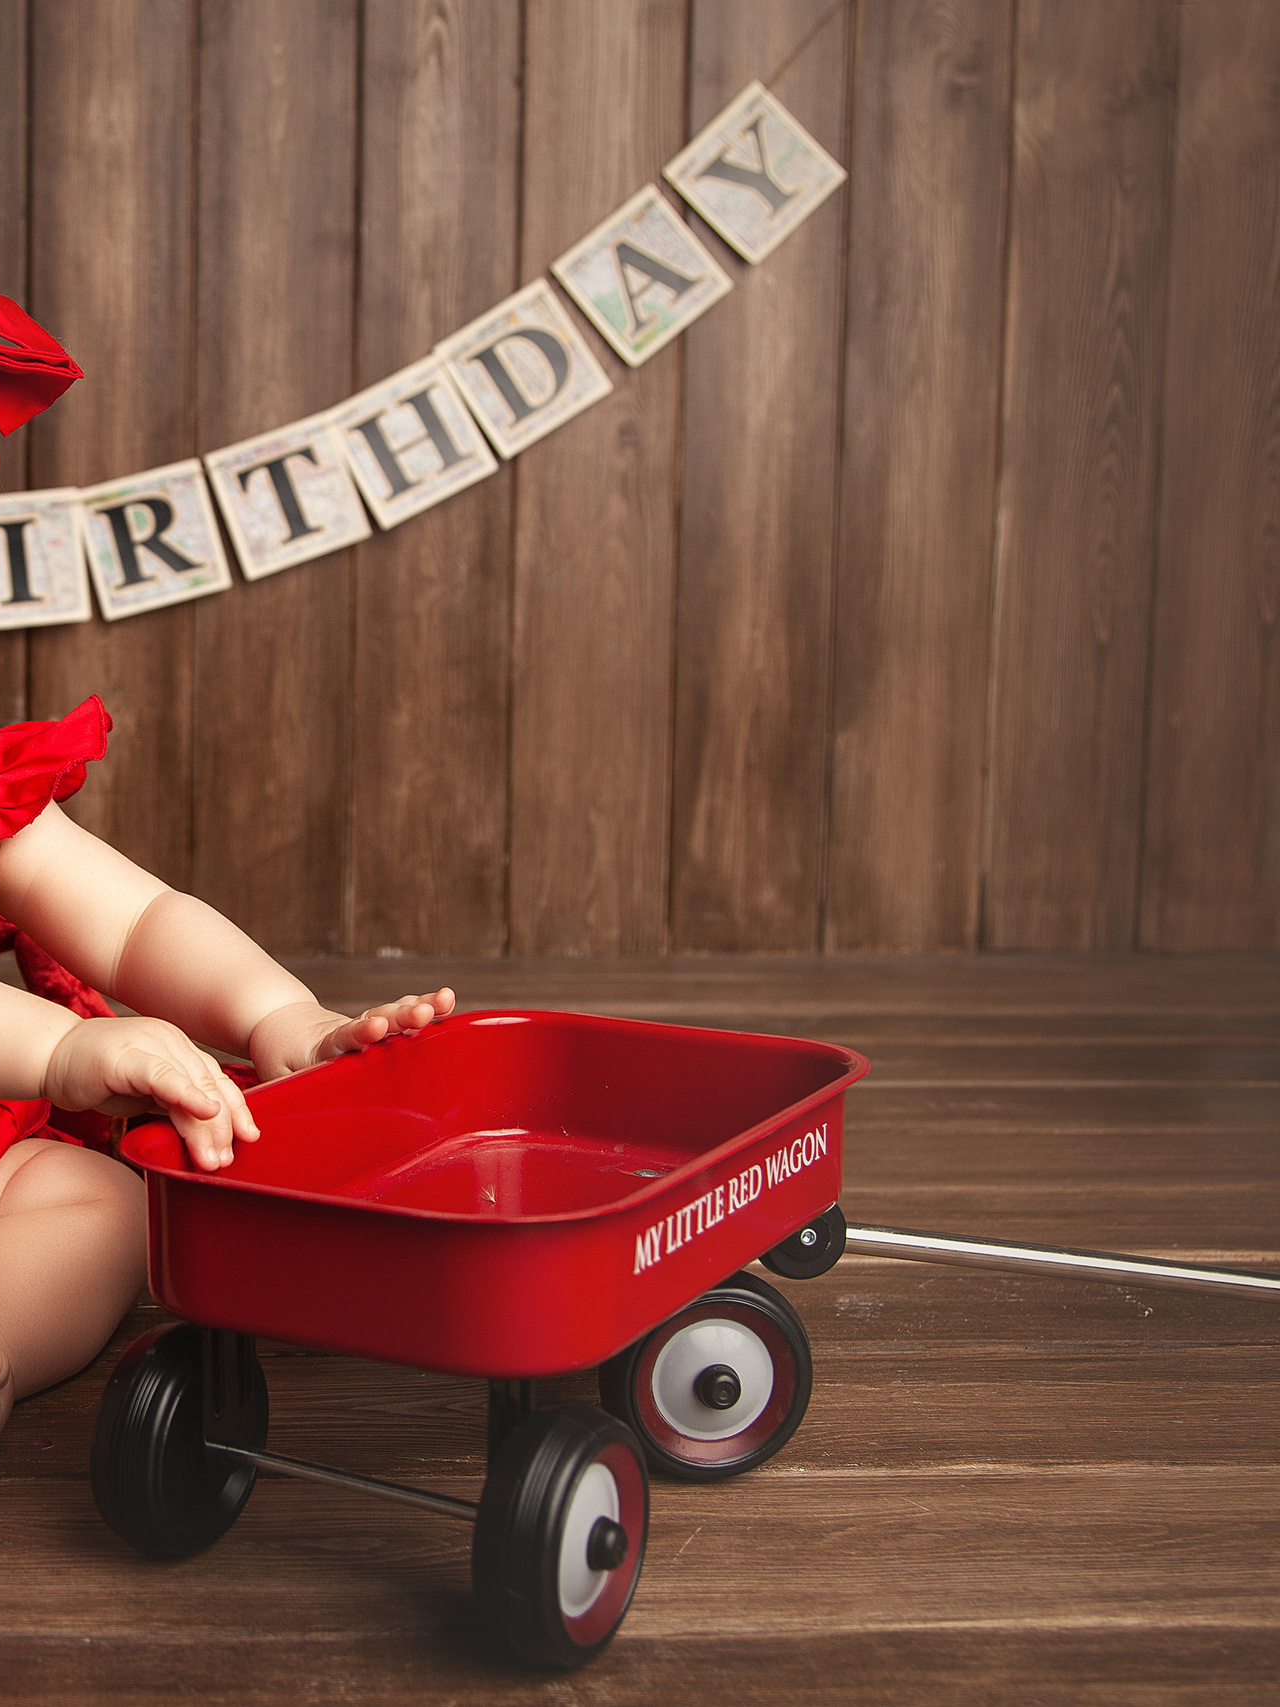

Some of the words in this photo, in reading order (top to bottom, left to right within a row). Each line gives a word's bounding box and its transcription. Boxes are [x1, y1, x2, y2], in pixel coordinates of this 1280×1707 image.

[633, 1221, 665, 1275] MY
[665, 1185, 725, 1254] LITTLE
[728, 1164, 762, 1215] RED
[765, 1123, 828, 1189] WAGON
